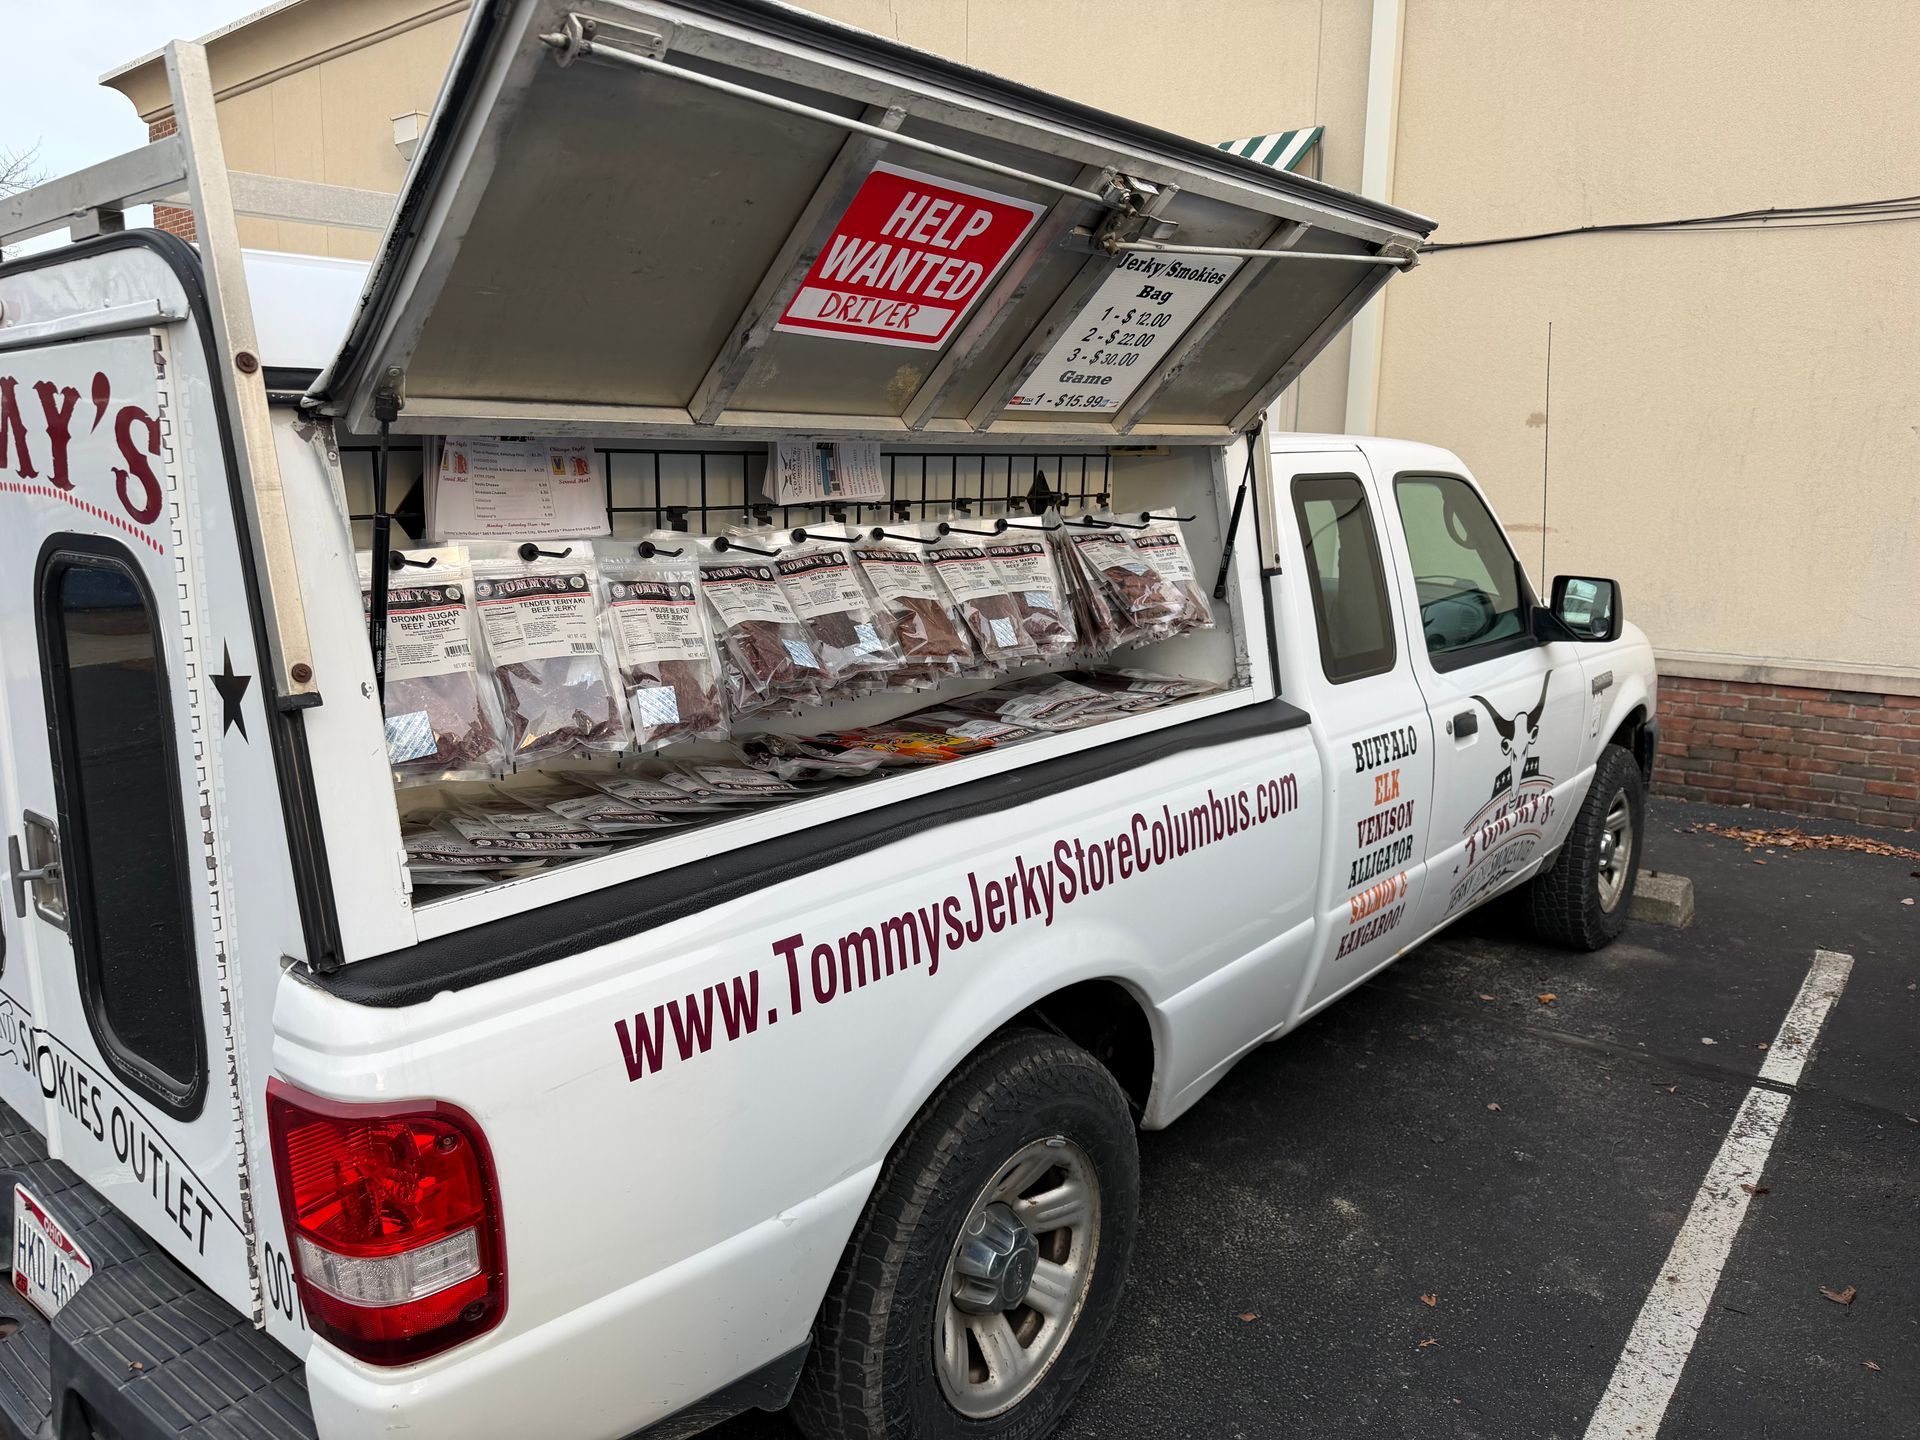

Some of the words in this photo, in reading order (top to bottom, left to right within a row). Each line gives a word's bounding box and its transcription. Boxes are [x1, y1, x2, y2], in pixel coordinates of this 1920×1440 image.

[880, 191, 994, 251] HELP
[818, 235, 985, 302] WANTED
[1117, 251, 1228, 285] Jerky/Smokies
[817, 292, 921, 330] DRIVER
[1136, 285, 1174, 305] Bag
[1136, 311, 1173, 328] 12.00
[1117, 333, 1156, 348] 22.00
[1059, 370, 1113, 386] Game
[1055, 393, 1104, 408] $15.99
[709, 566, 759, 580] TOMMY'S
[781, 554, 832, 573] TOMMY'S
[495, 577, 568, 596] TOMMY'S
[627, 582, 678, 597] TOMMY'S
[390, 615, 426, 624] BROWN
[428, 610, 461, 621] SUGAR
[520, 599, 552, 609] TENDER
[400, 622, 424, 631] BEEF
[427, 618, 457, 630] JERKY
[1352, 724, 1418, 773] BUFFALO
[1374, 768, 1400, 805] ELK
[1357, 799, 1415, 849] VENISON
[1465, 789, 1554, 868] TOMMY'S
[1348, 834, 1413, 889] ALLIGATOR
[1350, 874, 1398, 925] SALMON
[614, 771, 1299, 1083] www.TommysJerkyStoreColumbus.com
[1334, 901, 1406, 961] KANGAROO!
[111, 1106, 213, 1256] OUTLET
[43, 1217, 63, 1248] OHIO
[18, 1217, 47, 1291] HKD
[16, 1275, 28, 1290] 25
